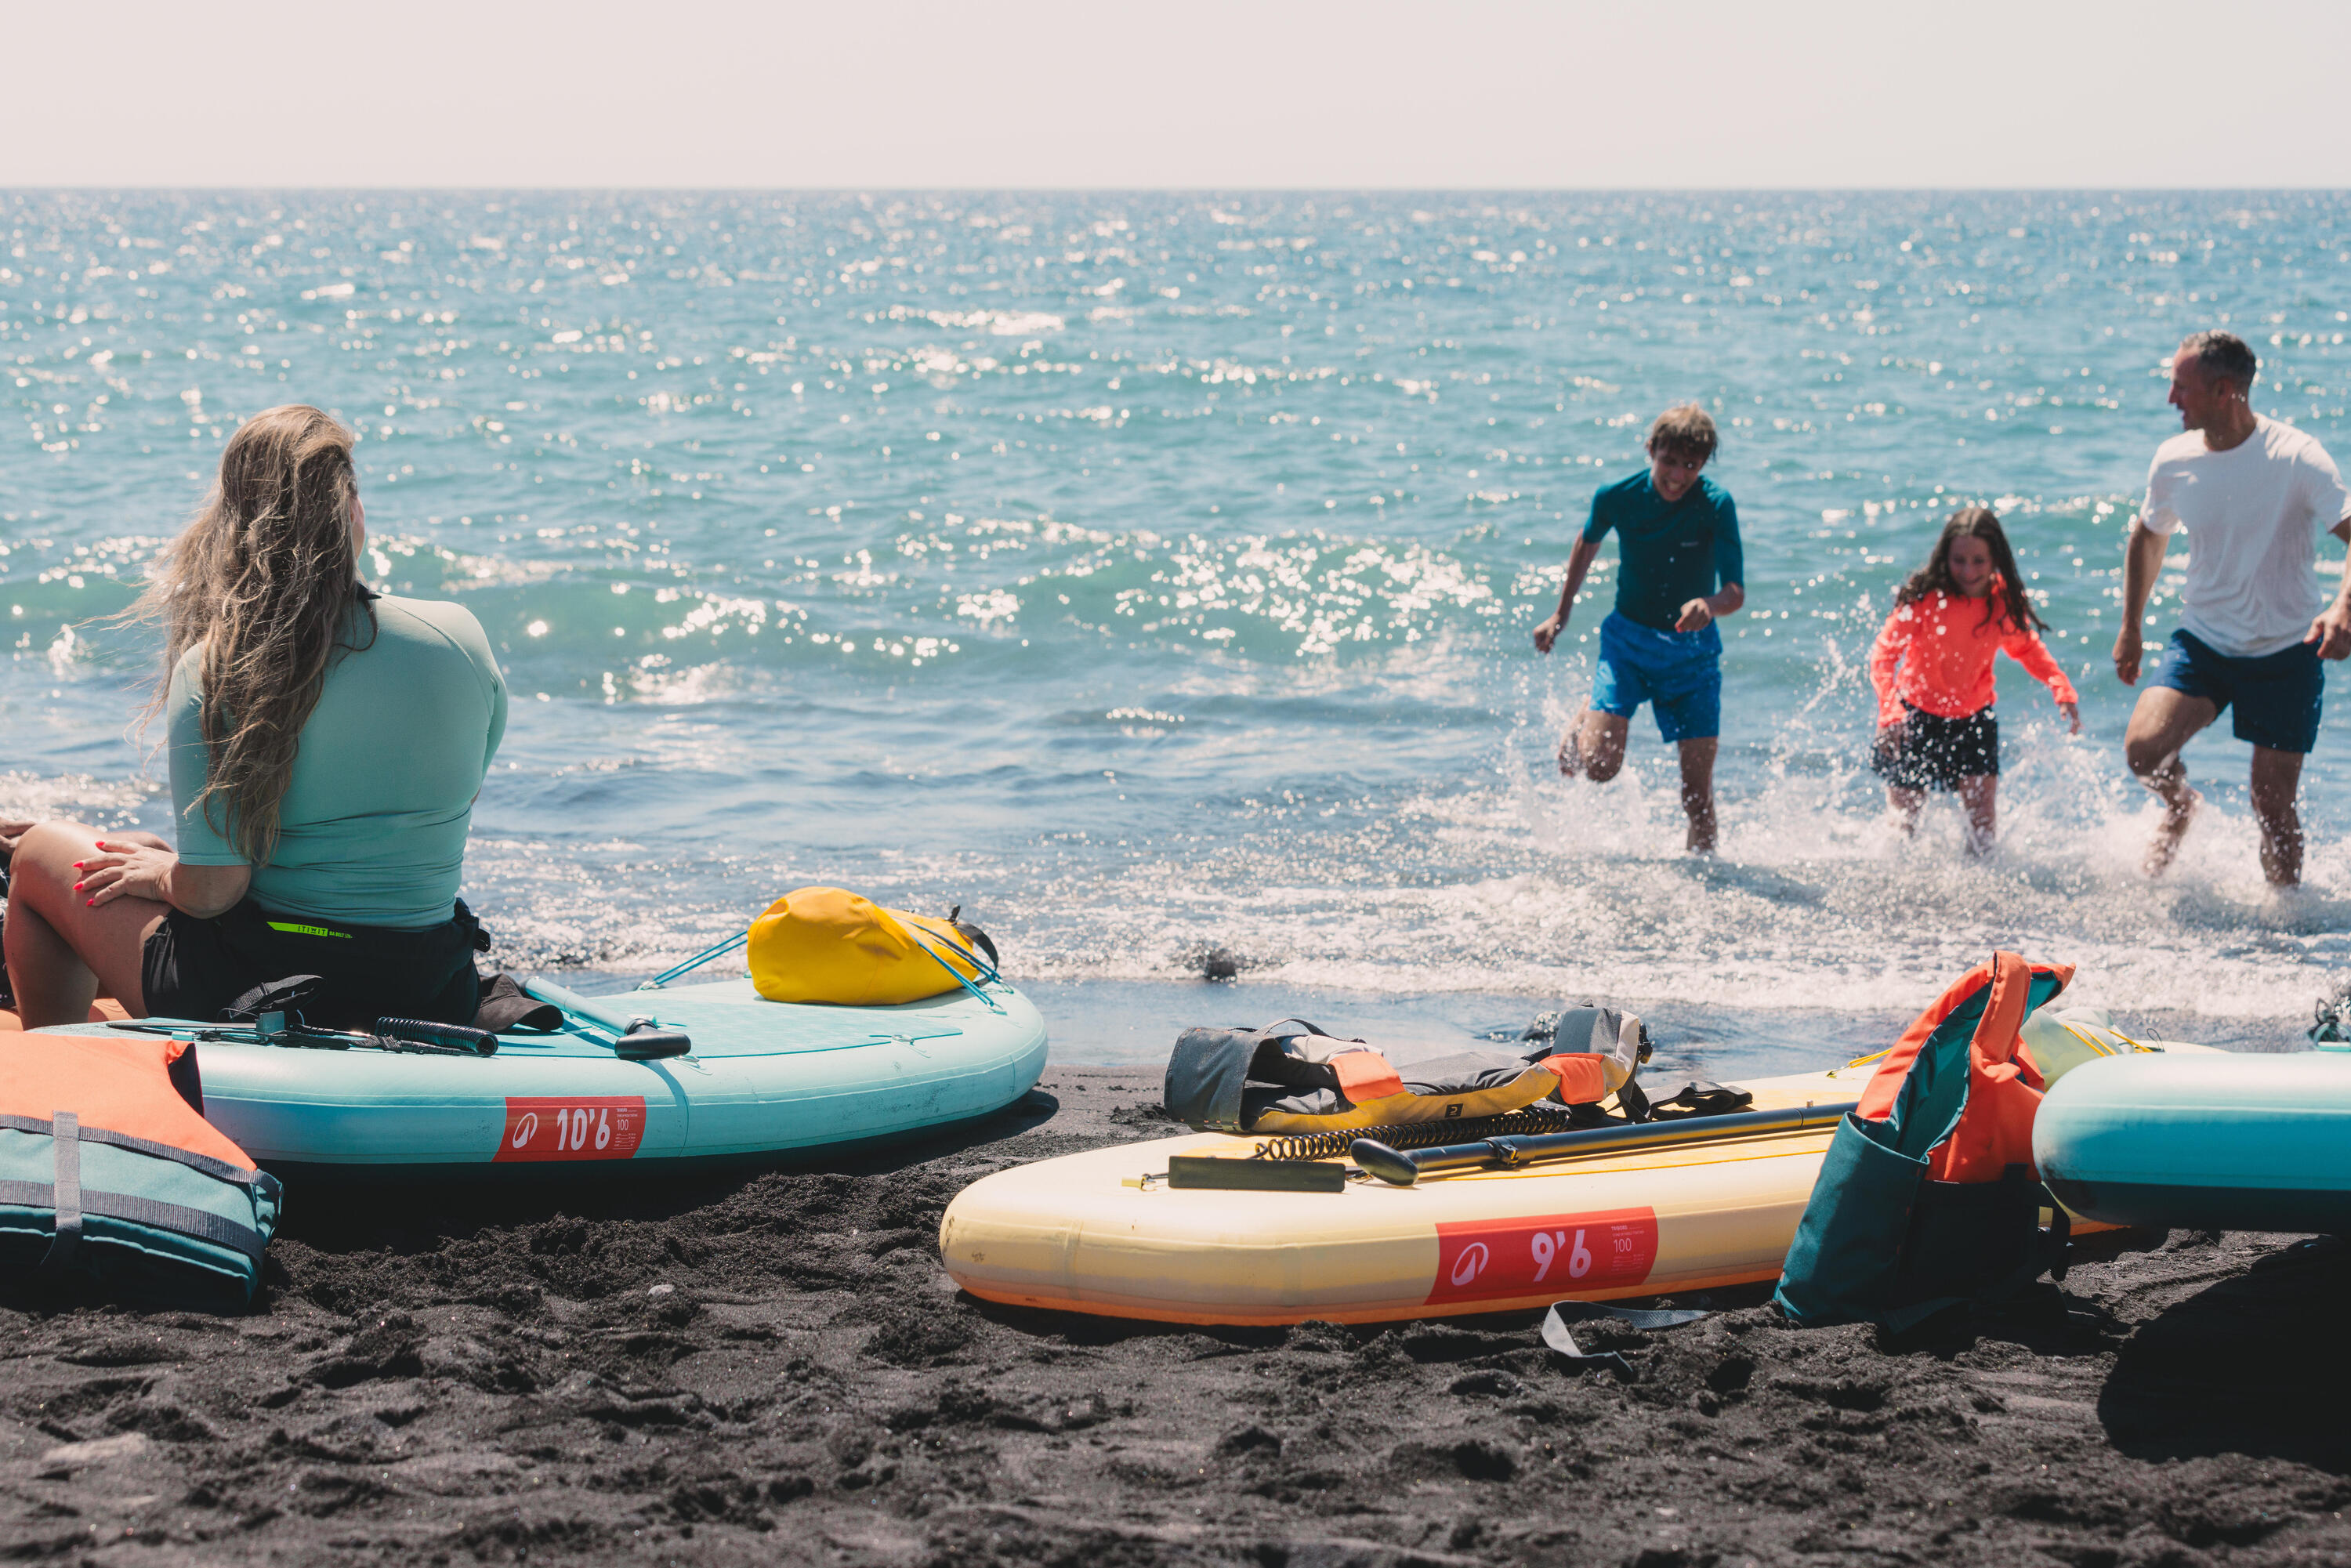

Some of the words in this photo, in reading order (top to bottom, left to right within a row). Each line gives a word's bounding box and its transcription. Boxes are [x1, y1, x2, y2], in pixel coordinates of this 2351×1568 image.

[299, 925, 326, 935] ITIWIT
[557, 1108, 610, 1151] 10'6
[617, 1119, 629, 1131] 100
[1614, 1238, 1632, 1254] 100
[1531, 1229, 1592, 1282] 9'6
